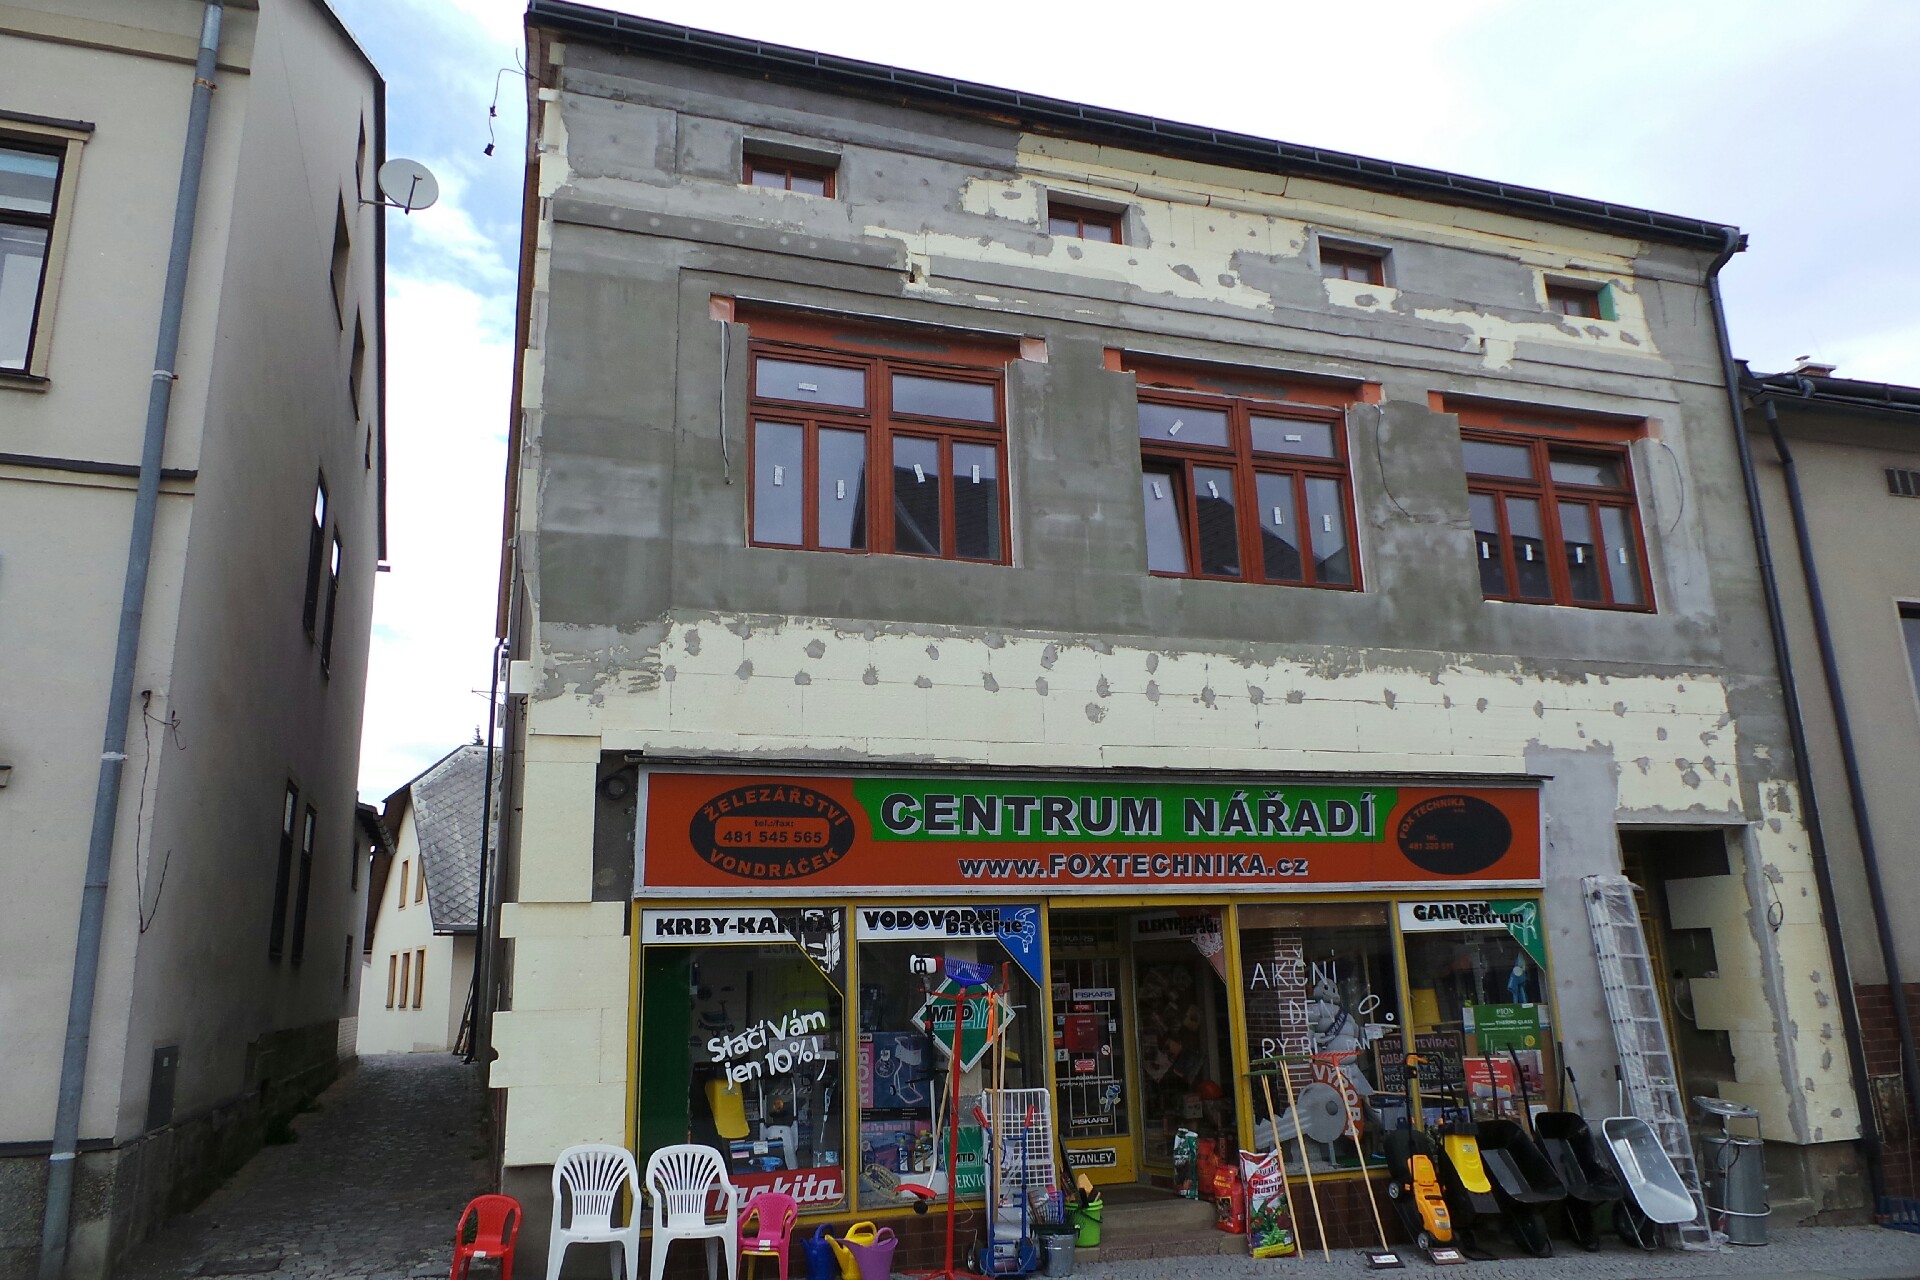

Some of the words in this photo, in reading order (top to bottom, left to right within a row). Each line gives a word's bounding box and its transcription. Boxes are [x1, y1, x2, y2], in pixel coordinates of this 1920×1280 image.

[703, 786, 848, 826] ŽELEZÁŘSTVÍ
[881, 793, 1162, 838] CENTRUM
[1183, 790, 1377, 837] NÁŘADÍ
[1399, 816, 1416, 840] FOX
[1414, 798, 1466, 818] TECHNIKA
[723, 831, 752, 844] 481
[759, 831, 788, 844] 545
[794, 831, 823, 844] 565
[709, 848, 840, 878] VONDRÁČEK
[958, 852, 1309, 879] www.FOXTECHNIKA.cz
[1413, 903, 1492, 921] GARDEN
[1459, 912, 1524, 925] centrum
[945, 916, 1024, 936] baterie
[1074, 990, 1113, 999] FISKARS
[932, 1004, 974, 1022] MTD
[707, 1019, 767, 1063] Stačí
[767, 1009, 826, 1041] Vám
[724, 1061, 762, 1091] jen
[765, 1036, 821, 1076] 10%!
[1072, 1116, 1110, 1126] FISKARS
[1068, 1152, 1112, 1165] STANLEY
